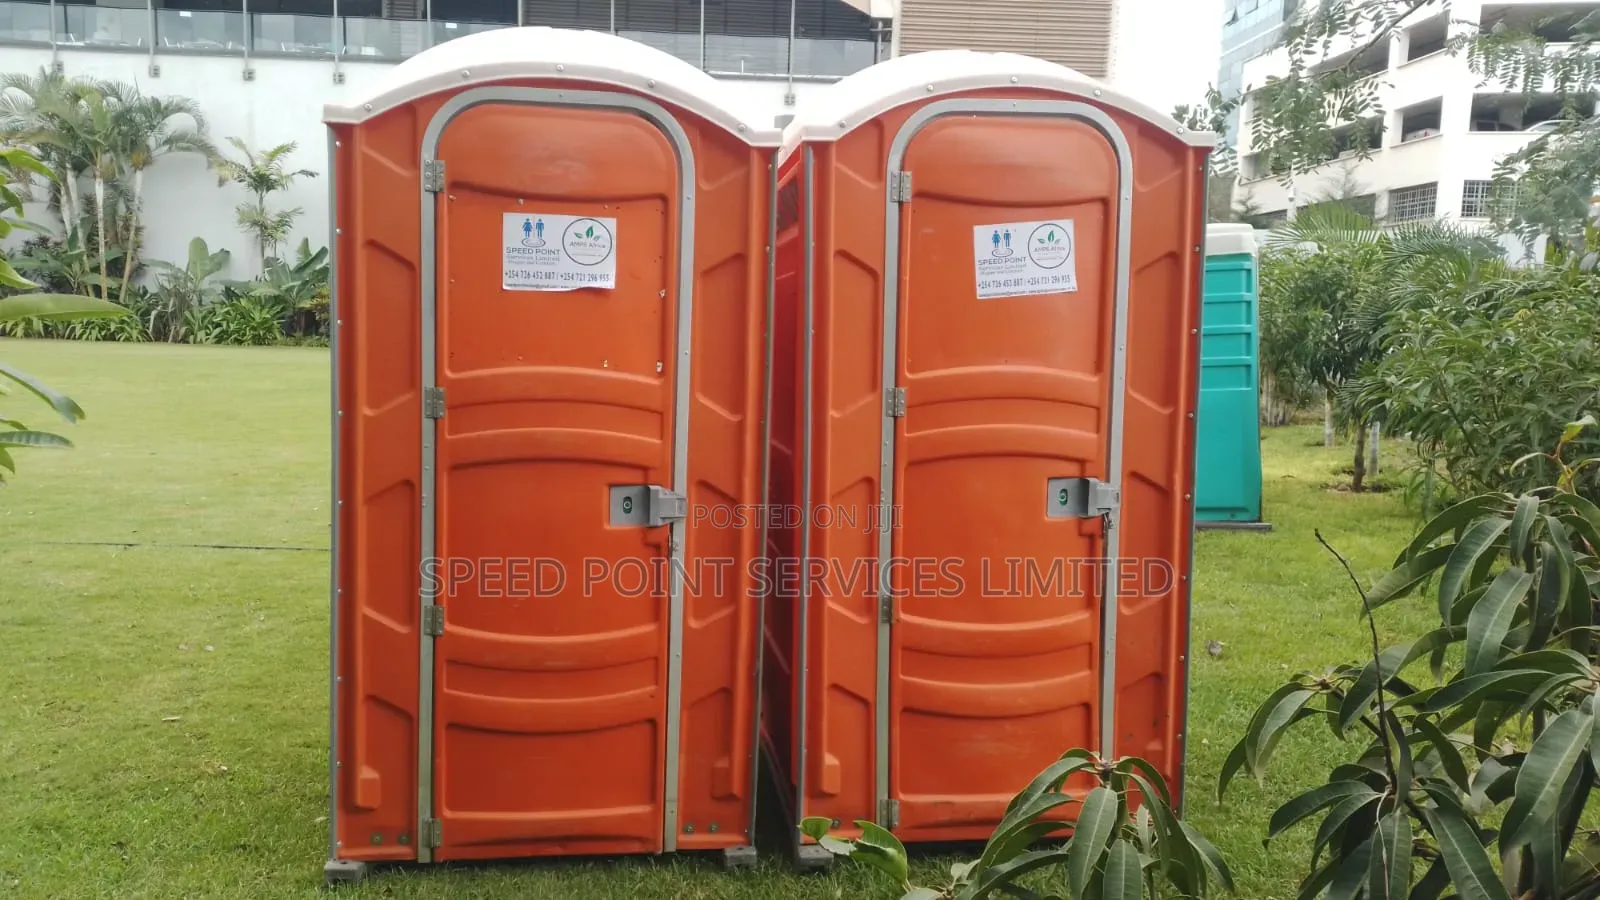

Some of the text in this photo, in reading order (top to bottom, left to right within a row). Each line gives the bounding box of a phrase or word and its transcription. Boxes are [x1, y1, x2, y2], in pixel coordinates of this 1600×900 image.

[506, 246, 534, 255] SPEED
[535, 247, 561, 256] POINT
[978, 258, 1003, 266] SPEED
[1004, 256, 1027, 264] POINT
